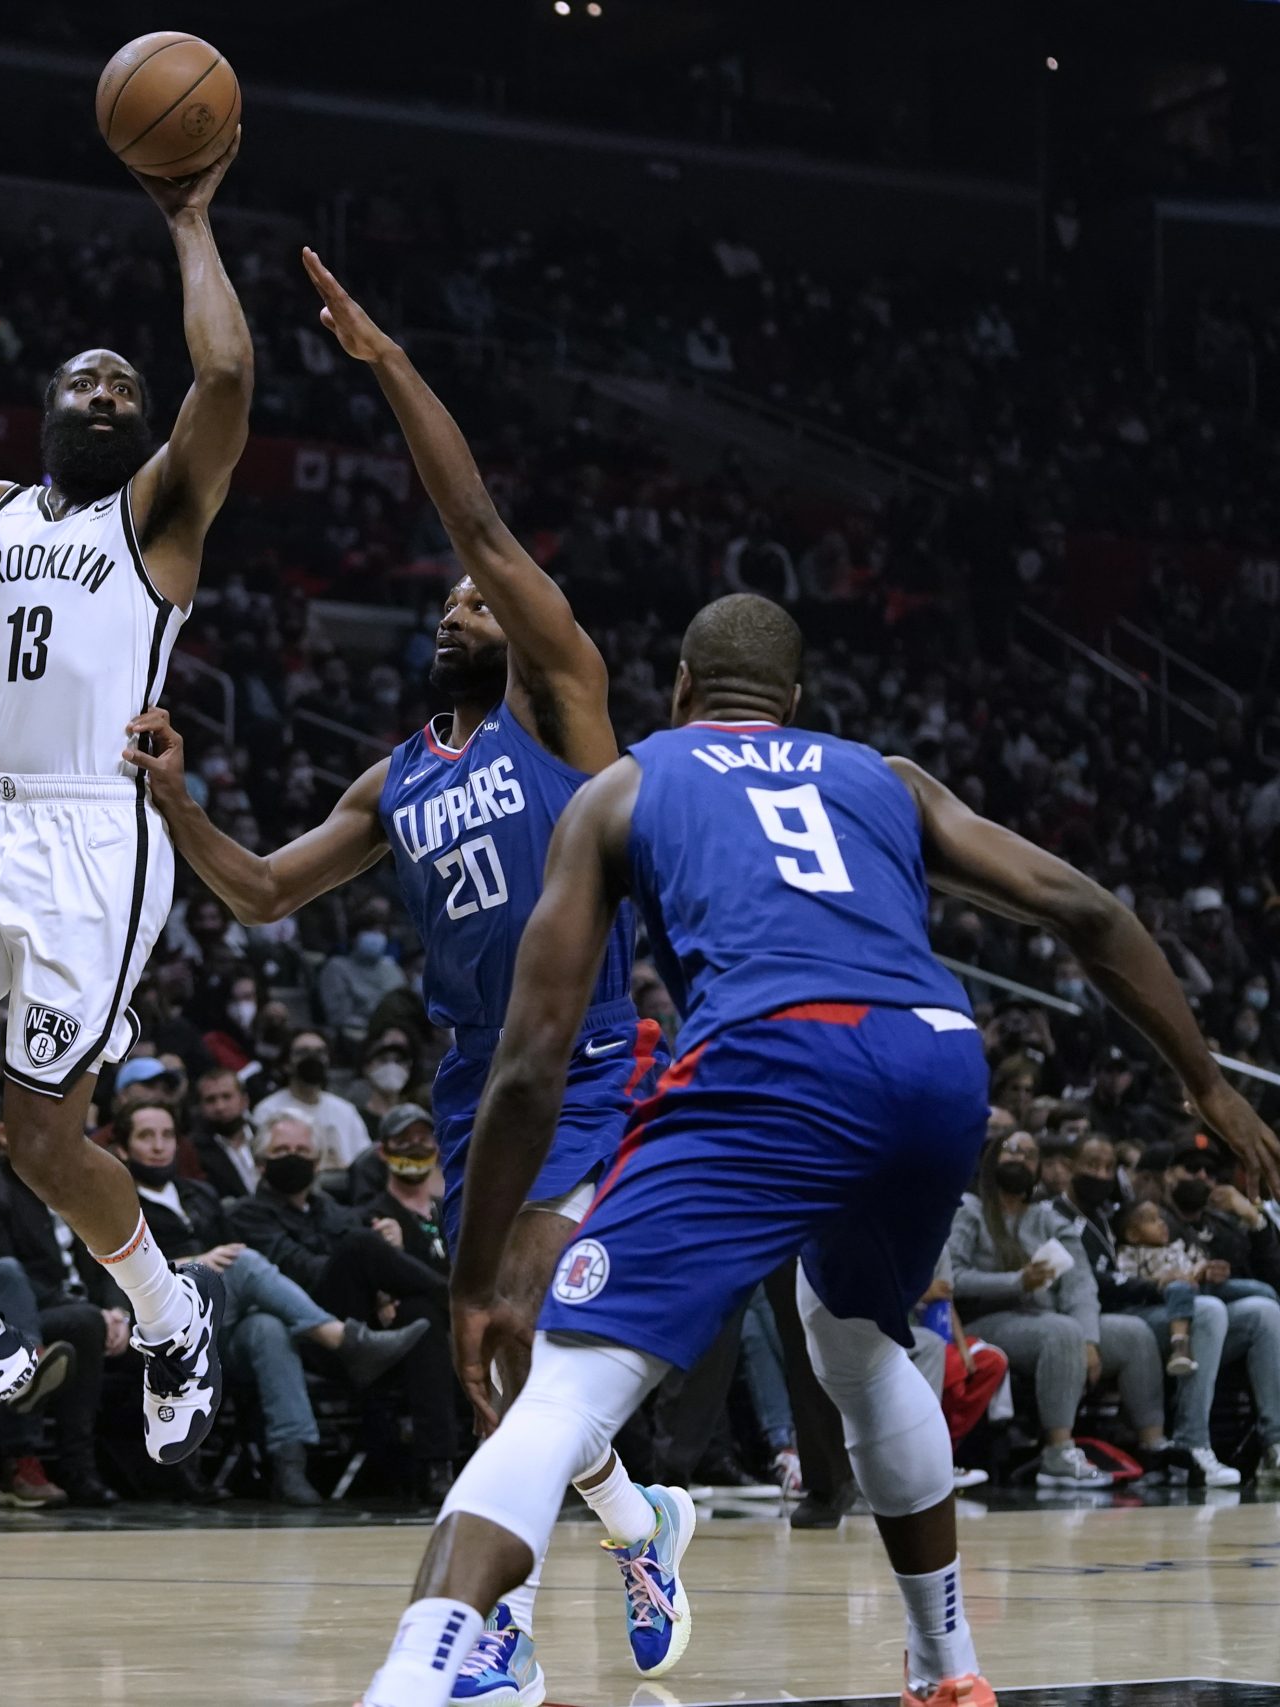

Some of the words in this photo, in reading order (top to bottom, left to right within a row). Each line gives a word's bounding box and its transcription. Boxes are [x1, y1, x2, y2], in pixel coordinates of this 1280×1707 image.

[7, 605, 53, 683] 13
[691, 740, 823, 775] IBAKA
[392, 755, 526, 864] CLIPPERS
[745, 782, 855, 893] 9
[433, 834, 509, 921] 20
[26, 1007, 76, 1044] NETS
